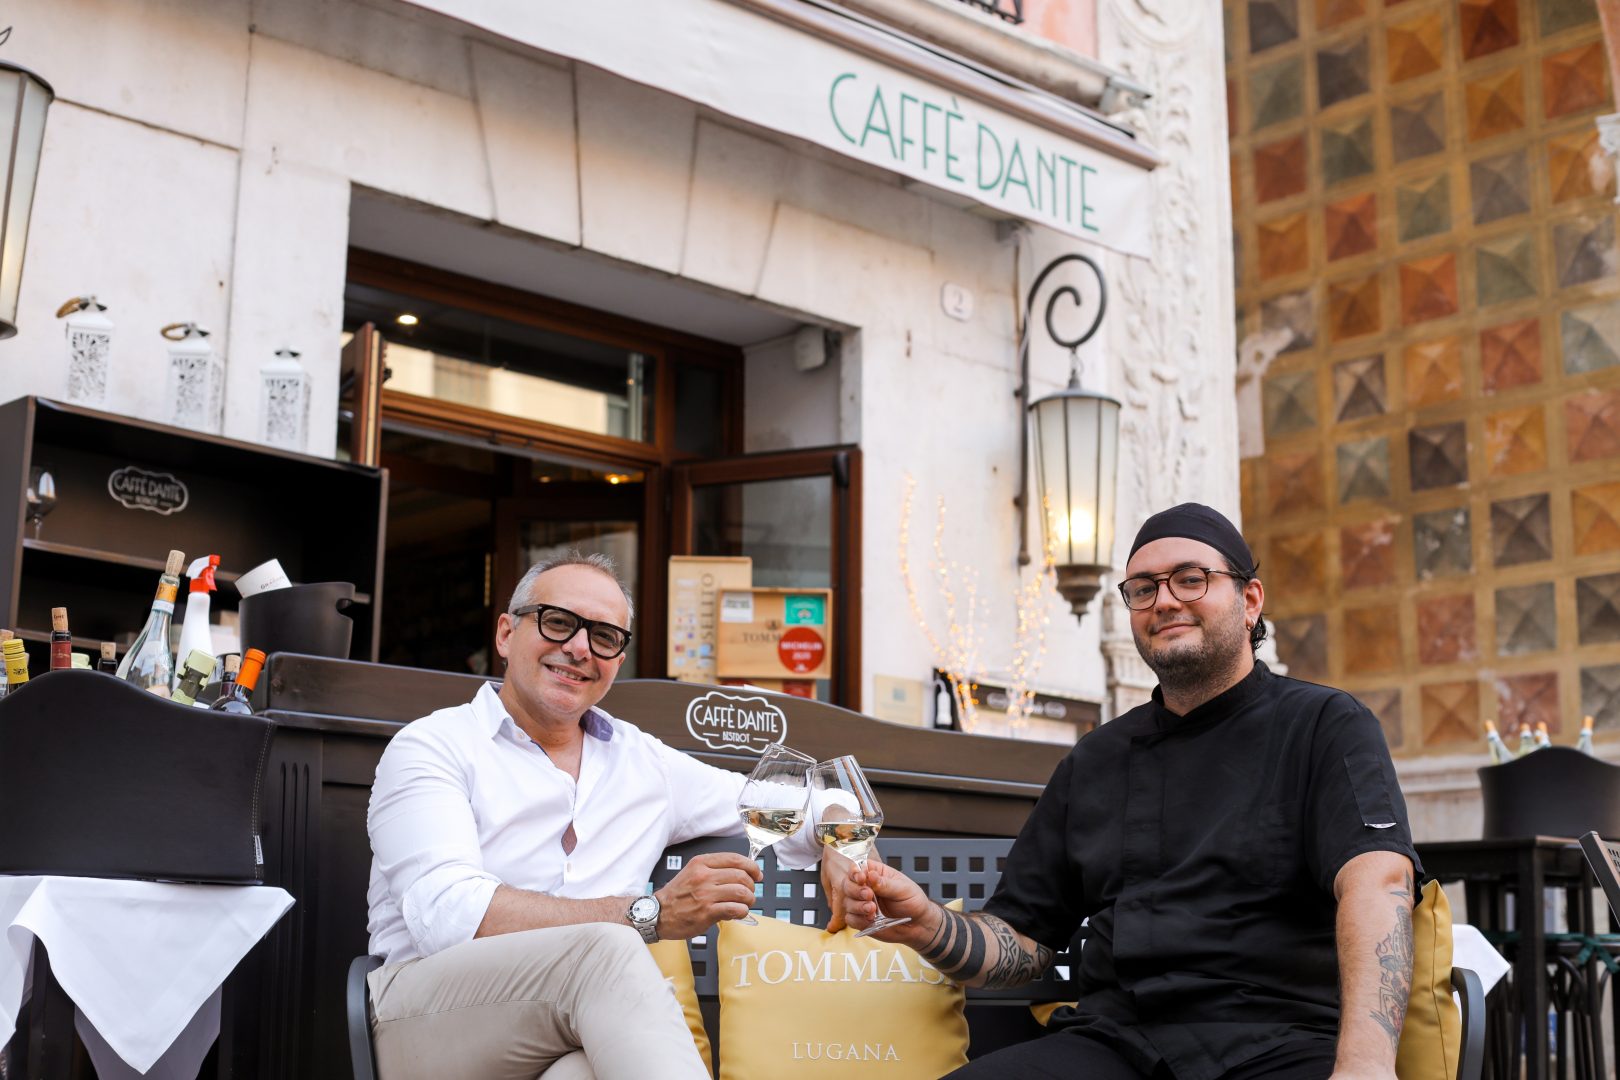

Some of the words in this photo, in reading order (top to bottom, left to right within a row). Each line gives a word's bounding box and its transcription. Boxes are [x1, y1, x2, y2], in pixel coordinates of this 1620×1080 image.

[829, 73, 965, 183] CAFFÈ
[977, 122, 1099, 232] DANTE
[148, 480, 181, 502] DANTE
[693, 703, 735, 729] CAFFÈ
[737, 708, 779, 733] DANTE
[722, 731, 751, 743] BISTROT
[791, 1042, 900, 1061] LUGANA
